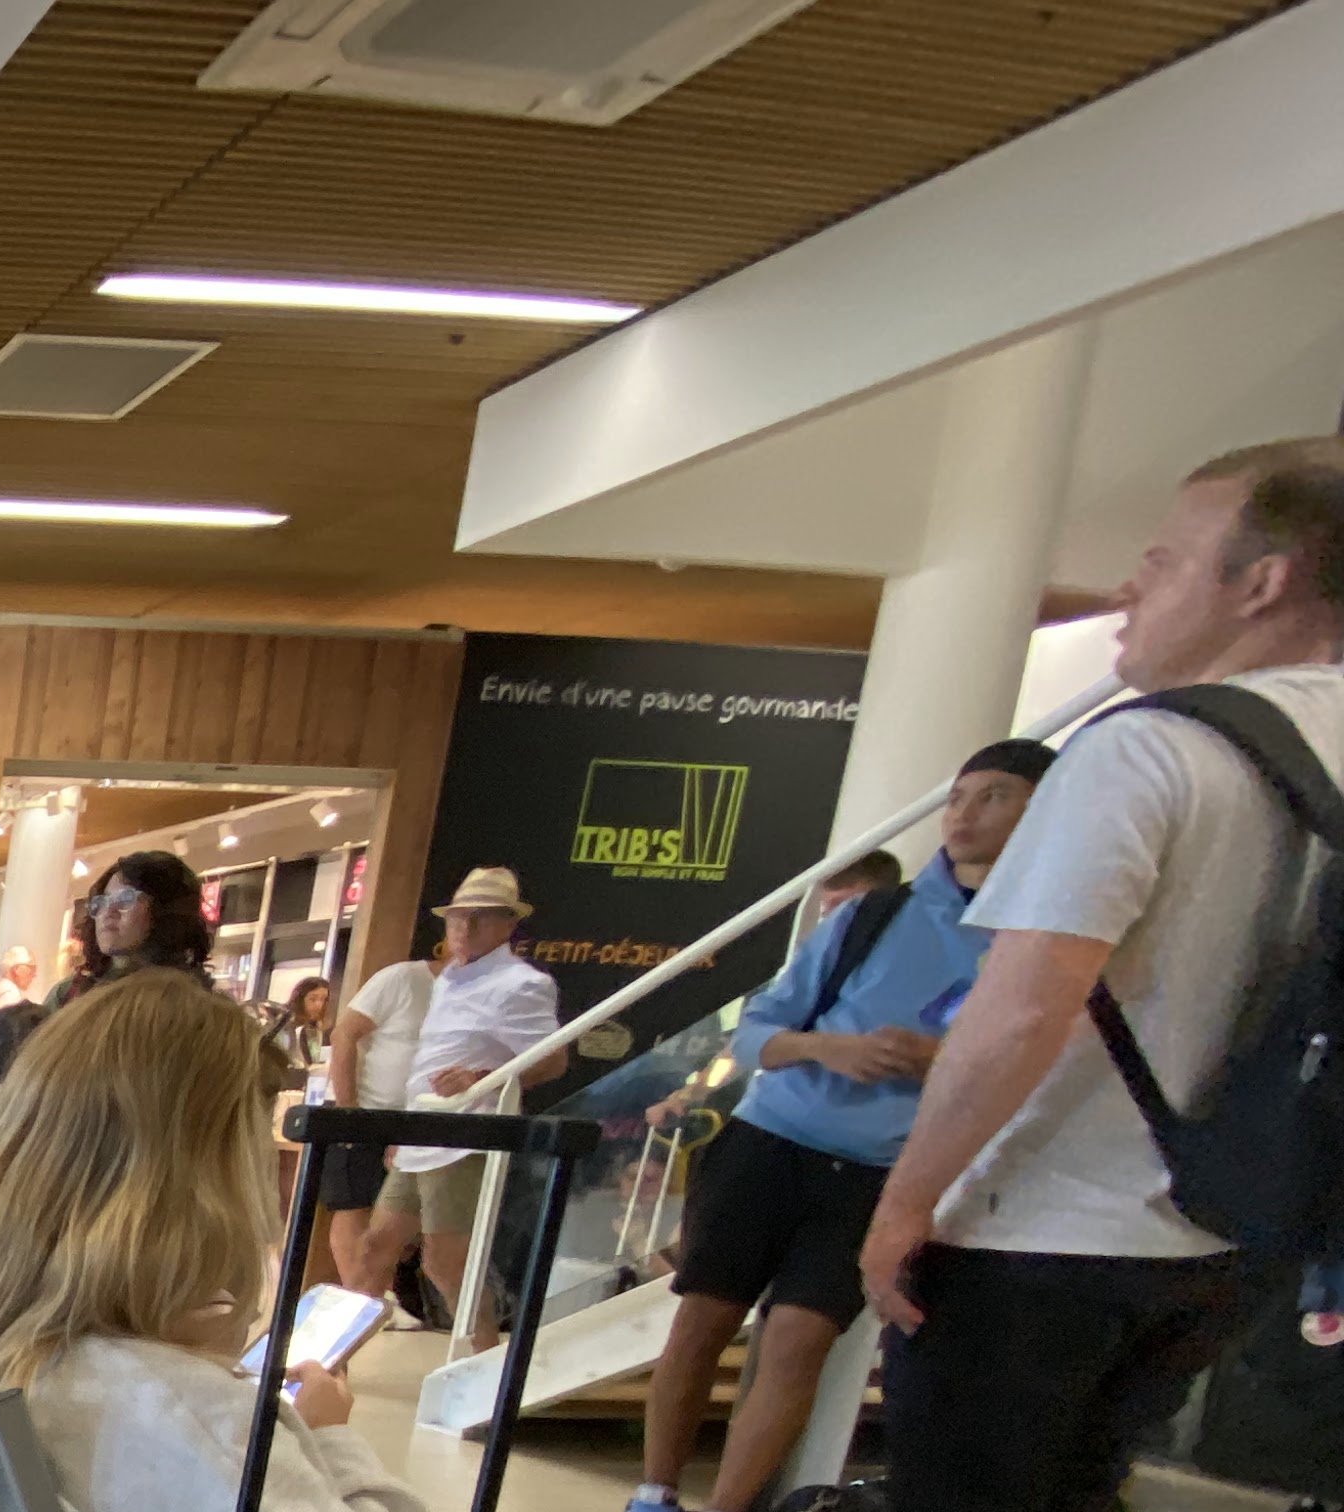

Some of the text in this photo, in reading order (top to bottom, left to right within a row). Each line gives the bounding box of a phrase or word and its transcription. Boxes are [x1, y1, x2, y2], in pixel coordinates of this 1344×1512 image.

[480, 671, 861, 724] Envie d'une pause gourmande
[577, 826, 681, 864] TRIB'S
